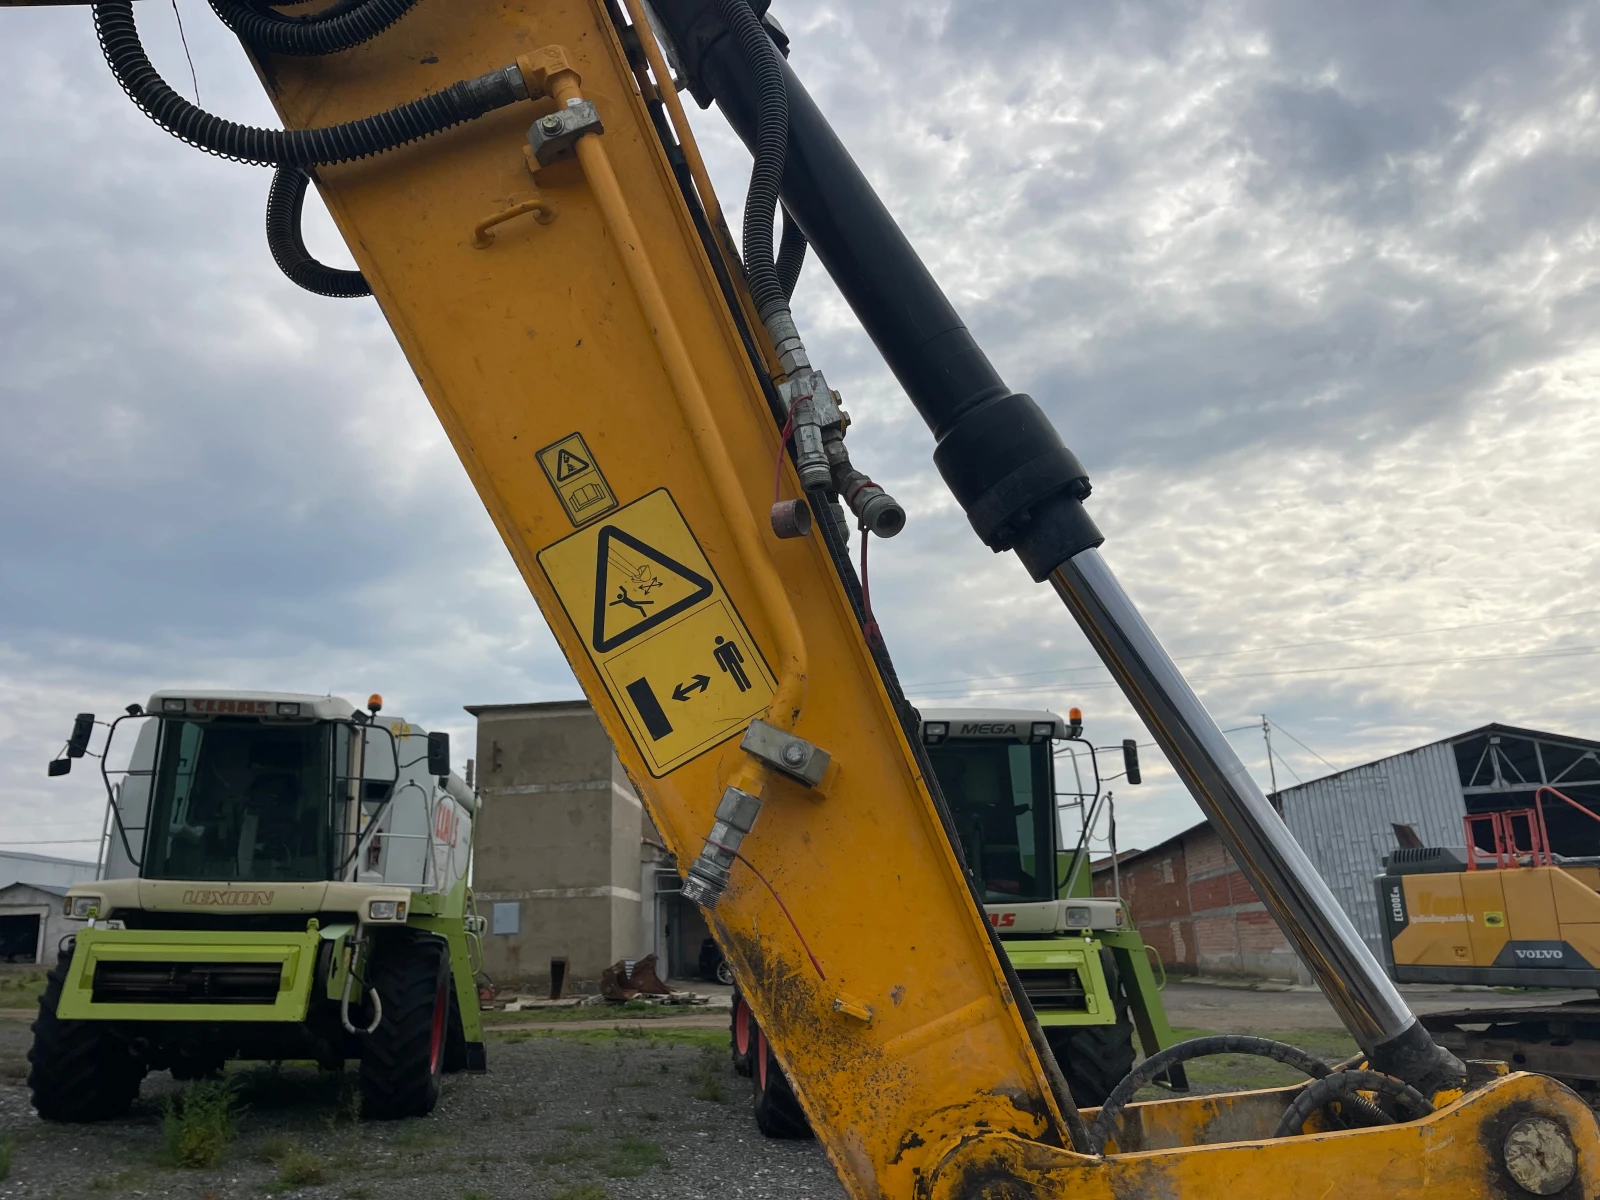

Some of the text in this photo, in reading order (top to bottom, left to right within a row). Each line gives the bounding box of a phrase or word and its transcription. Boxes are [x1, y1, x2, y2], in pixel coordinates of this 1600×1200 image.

[193, 700, 272, 714] CLAAS
[960, 723, 1016, 734] MEGA
[182, 890, 274, 906] LEXION
[1515, 949, 1563, 959] VOLVO
